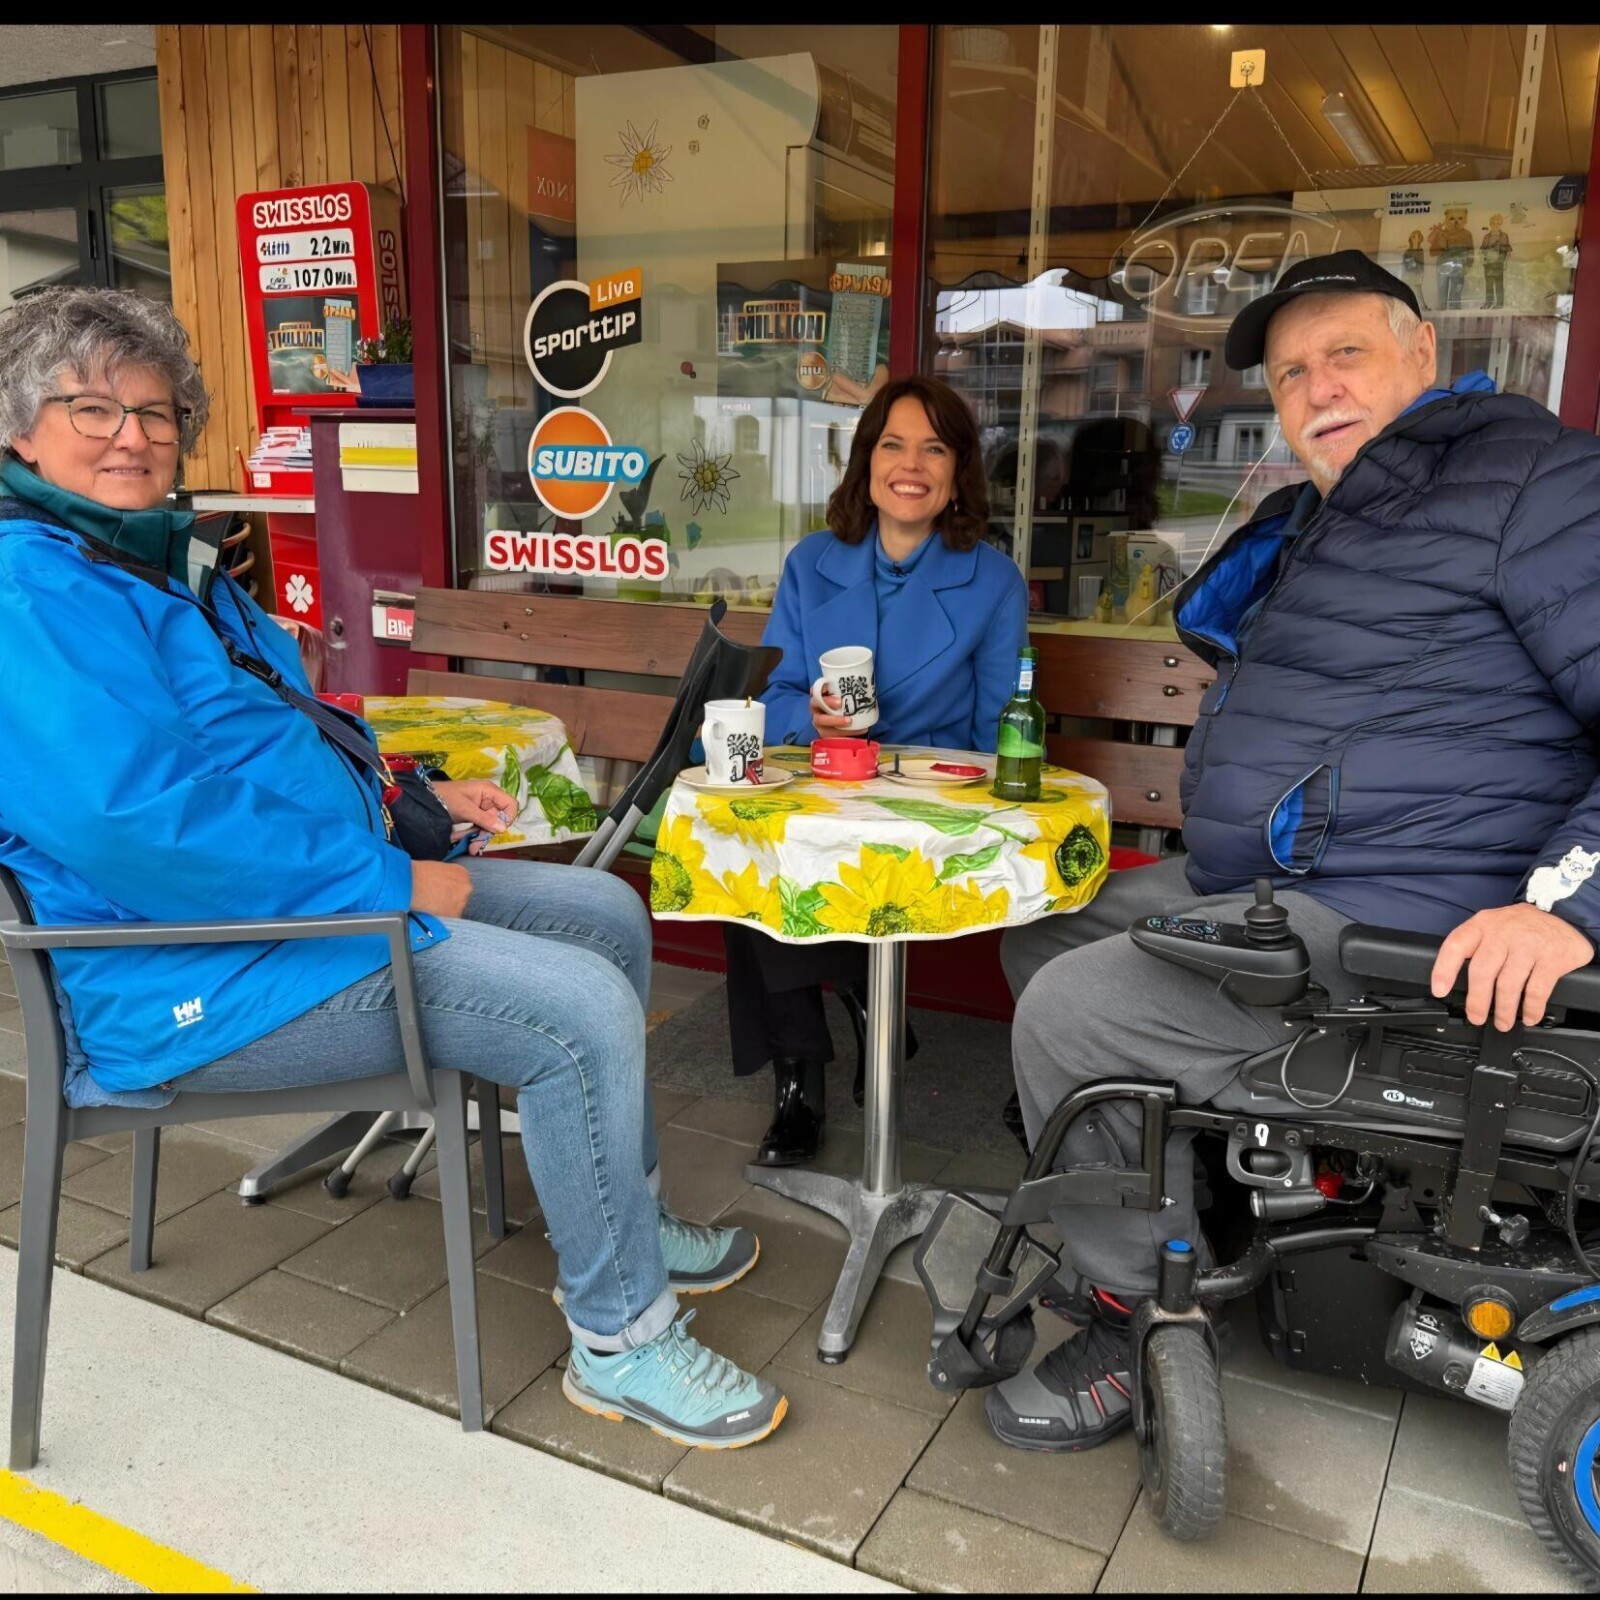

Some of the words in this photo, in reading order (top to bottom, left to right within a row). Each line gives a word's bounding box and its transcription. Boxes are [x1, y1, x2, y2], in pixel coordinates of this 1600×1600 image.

[254, 194, 350, 227] SWISSLOS
[294, 267, 333, 288] 107,0
[597, 280, 635, 303] Live
[536, 450, 644, 478] SUBITO
[488, 534, 667, 577] SWISSLOS
